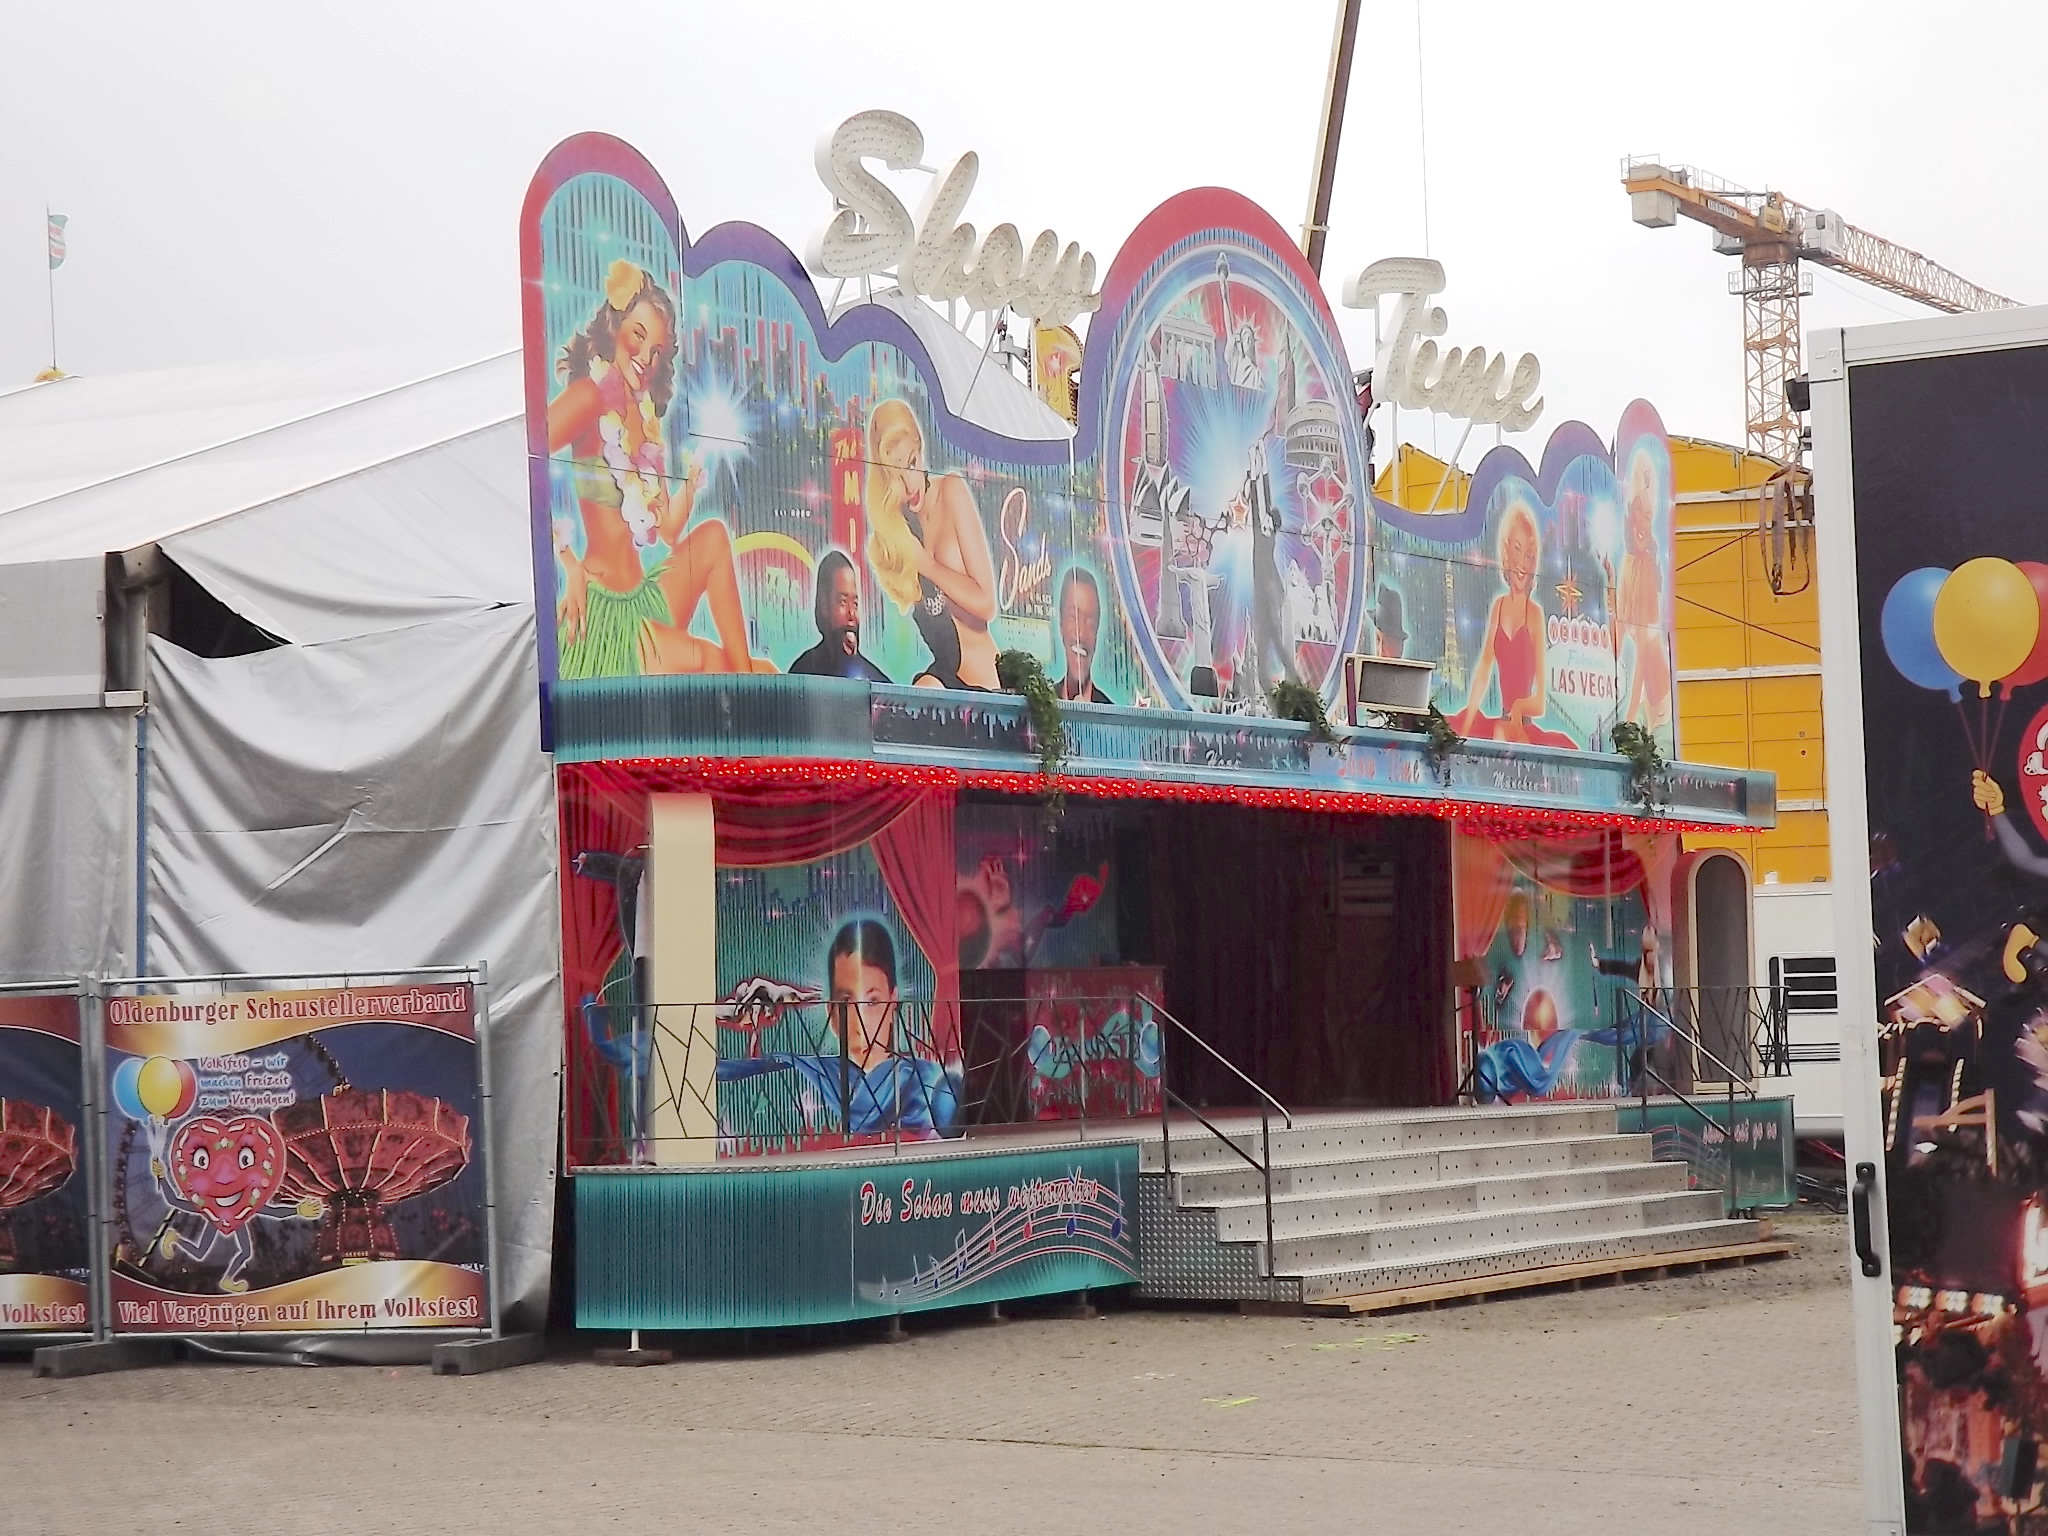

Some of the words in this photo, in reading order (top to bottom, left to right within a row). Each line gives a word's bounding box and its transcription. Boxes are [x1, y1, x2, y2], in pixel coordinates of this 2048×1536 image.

[806, 108, 1102, 326] Show
[1341, 256, 1544, 433] Time
[999, 487, 1051, 612] Sands
[1551, 667, 1575, 695] LAS
[1493, 770, 1538, 791] München
[110, 999, 239, 1025] Oldenburger
[246, 986, 467, 1020] Schaustellerverband
[200, 1055, 248, 1071] Volksfest
[265, 1053, 288, 1068] wir
[200, 1077, 242, 1088] machen
[246, 1073, 291, 1087] Freizeit
[201, 1096, 229, 1107] zum
[231, 1091, 296, 1108] Vergnügen!
[860, 1181, 893, 1226] Die
[900, 1178, 953, 1222] Schau
[960, 1186, 1000, 1215] muss
[2, 1301, 87, 1325] Volksfest
[118, 1300, 158, 1324] Viel
[162, 1299, 269, 1328] Vergnügen
[276, 1301, 309, 1321] auf
[316, 1299, 377, 1320] Ihrem
[382, 1295, 480, 1319] Volksfest
